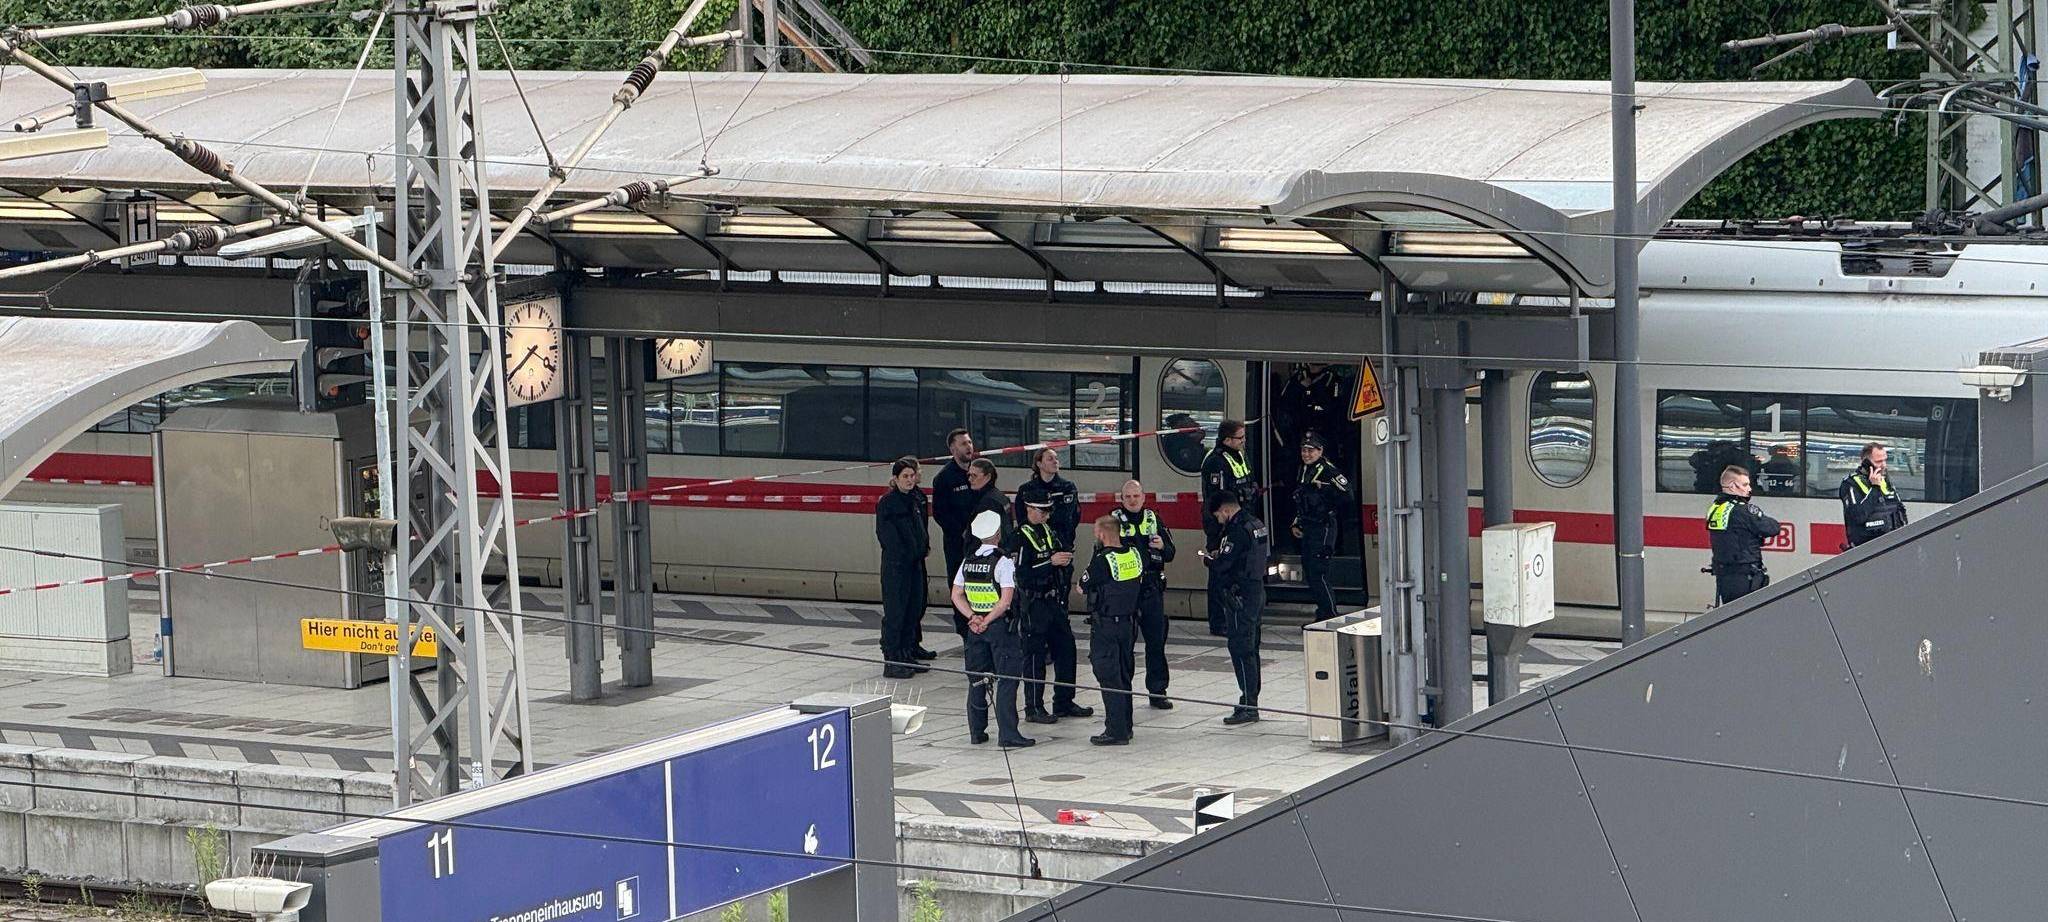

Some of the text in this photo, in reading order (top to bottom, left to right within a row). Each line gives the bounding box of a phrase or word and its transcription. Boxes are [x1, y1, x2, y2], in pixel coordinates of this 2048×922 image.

[134, 203, 152, 241] H
[1088, 381, 1106, 416] 2
[1765, 402, 1786, 439] 1
[963, 563, 991, 574] POLIZEI
[308, 621, 339, 637] Hier
[343, 624, 380, 640] nicht
[360, 641, 383, 651] Don't
[807, 723, 836, 771] 12
[426, 828, 454, 879] 11
[490, 889, 603, 922] eneinhausung
